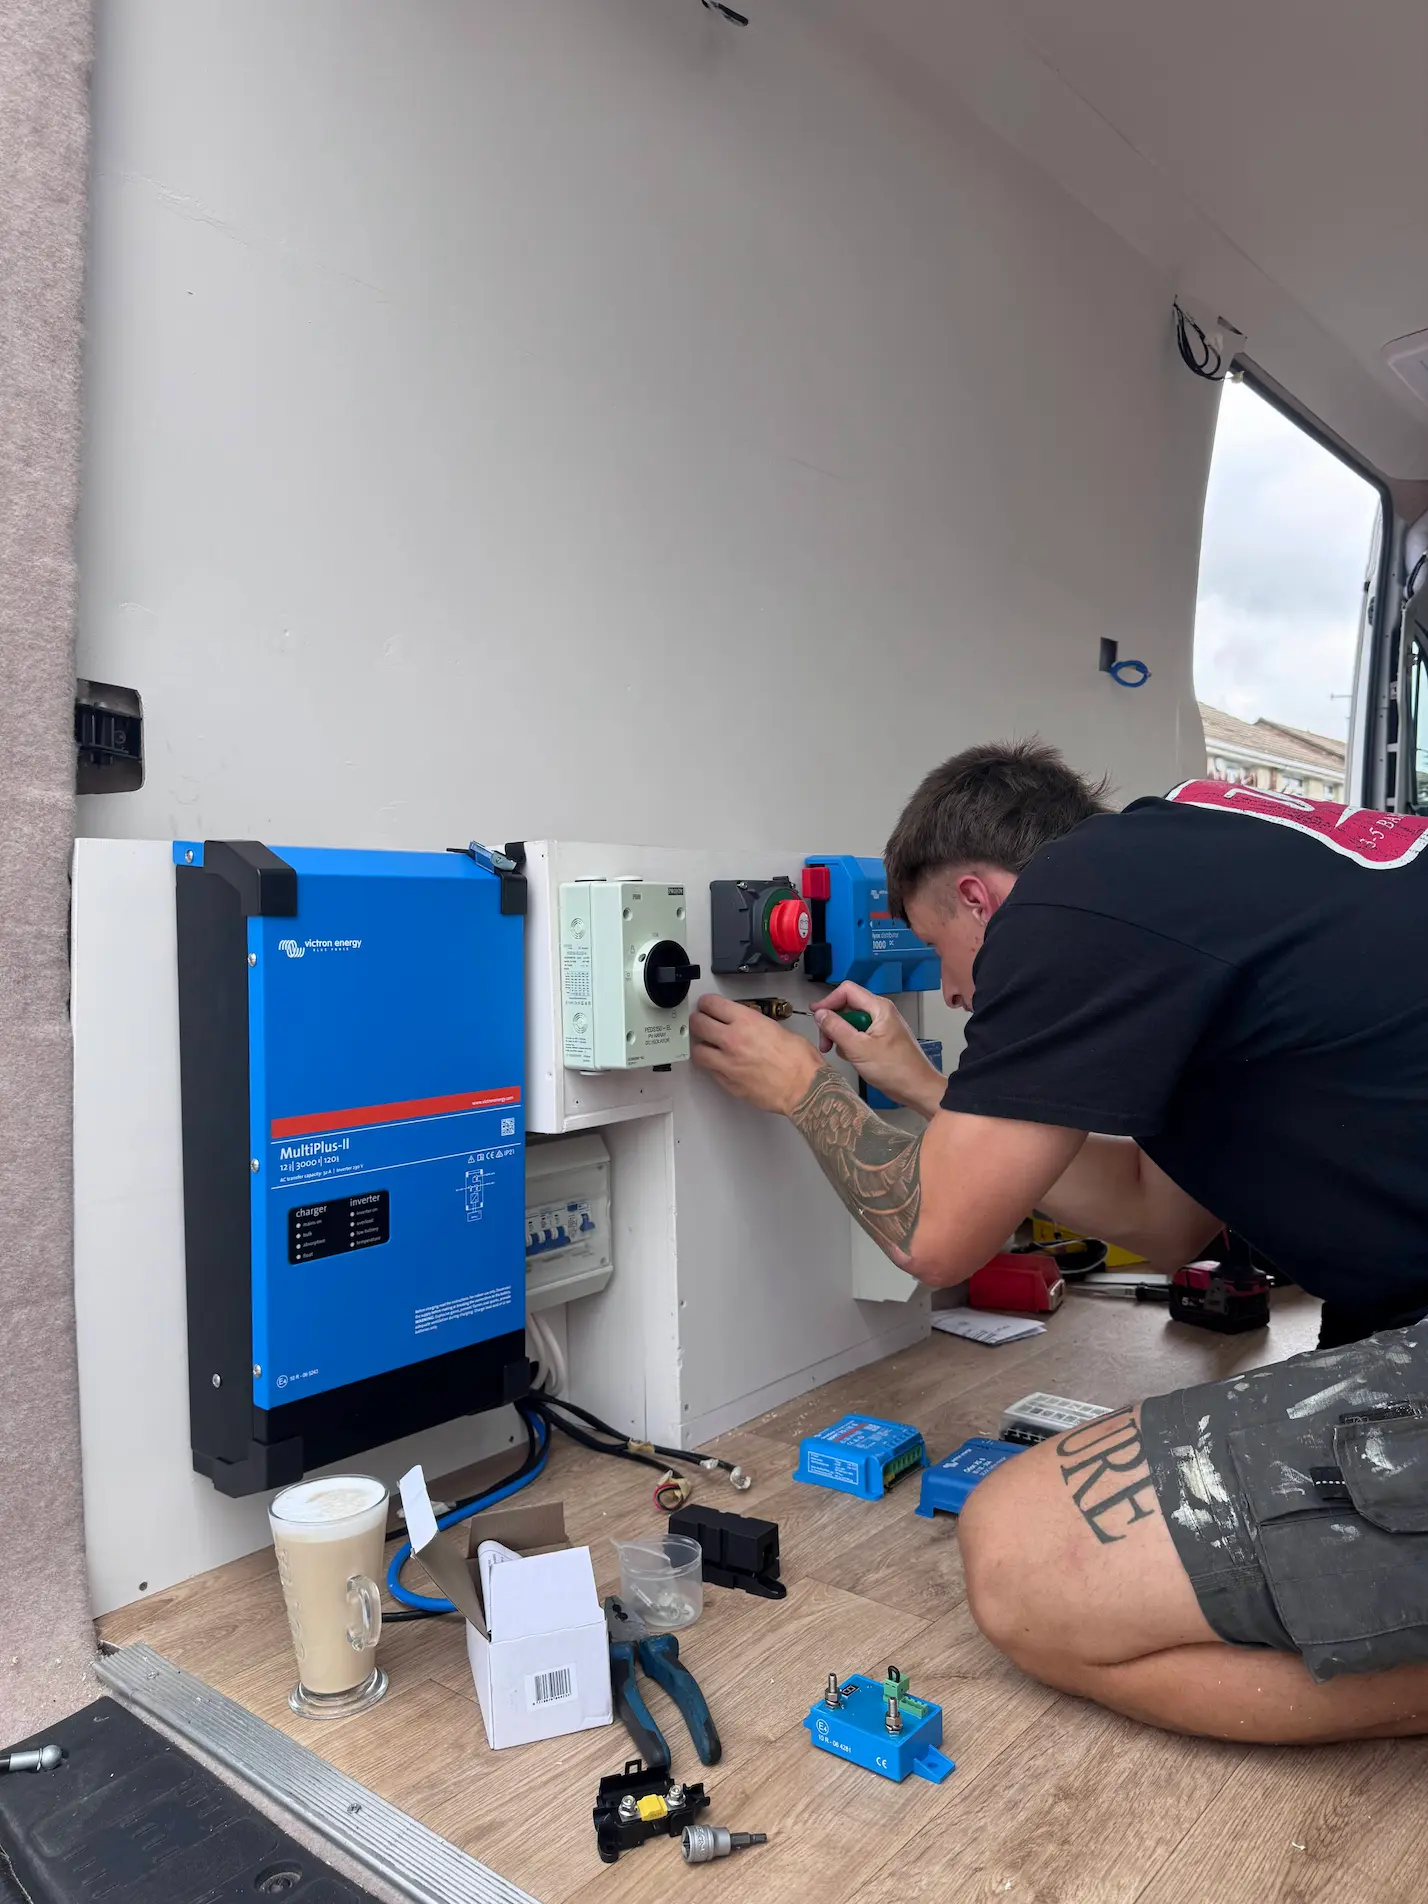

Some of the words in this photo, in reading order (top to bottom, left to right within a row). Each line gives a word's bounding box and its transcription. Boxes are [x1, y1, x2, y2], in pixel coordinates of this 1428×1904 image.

[1360, 827, 1384, 848] 3-5
[304, 938, 332, 948] victron
[334, 940, 362, 949] energy
[872, 940, 886, 950] 1000
[280, 1138, 350, 1160] MultiPlus-II
[350, 1194, 380, 1206] inverter
[296, 1206, 328, 1218] charger
[840, 1742, 852, 1753] 4281
